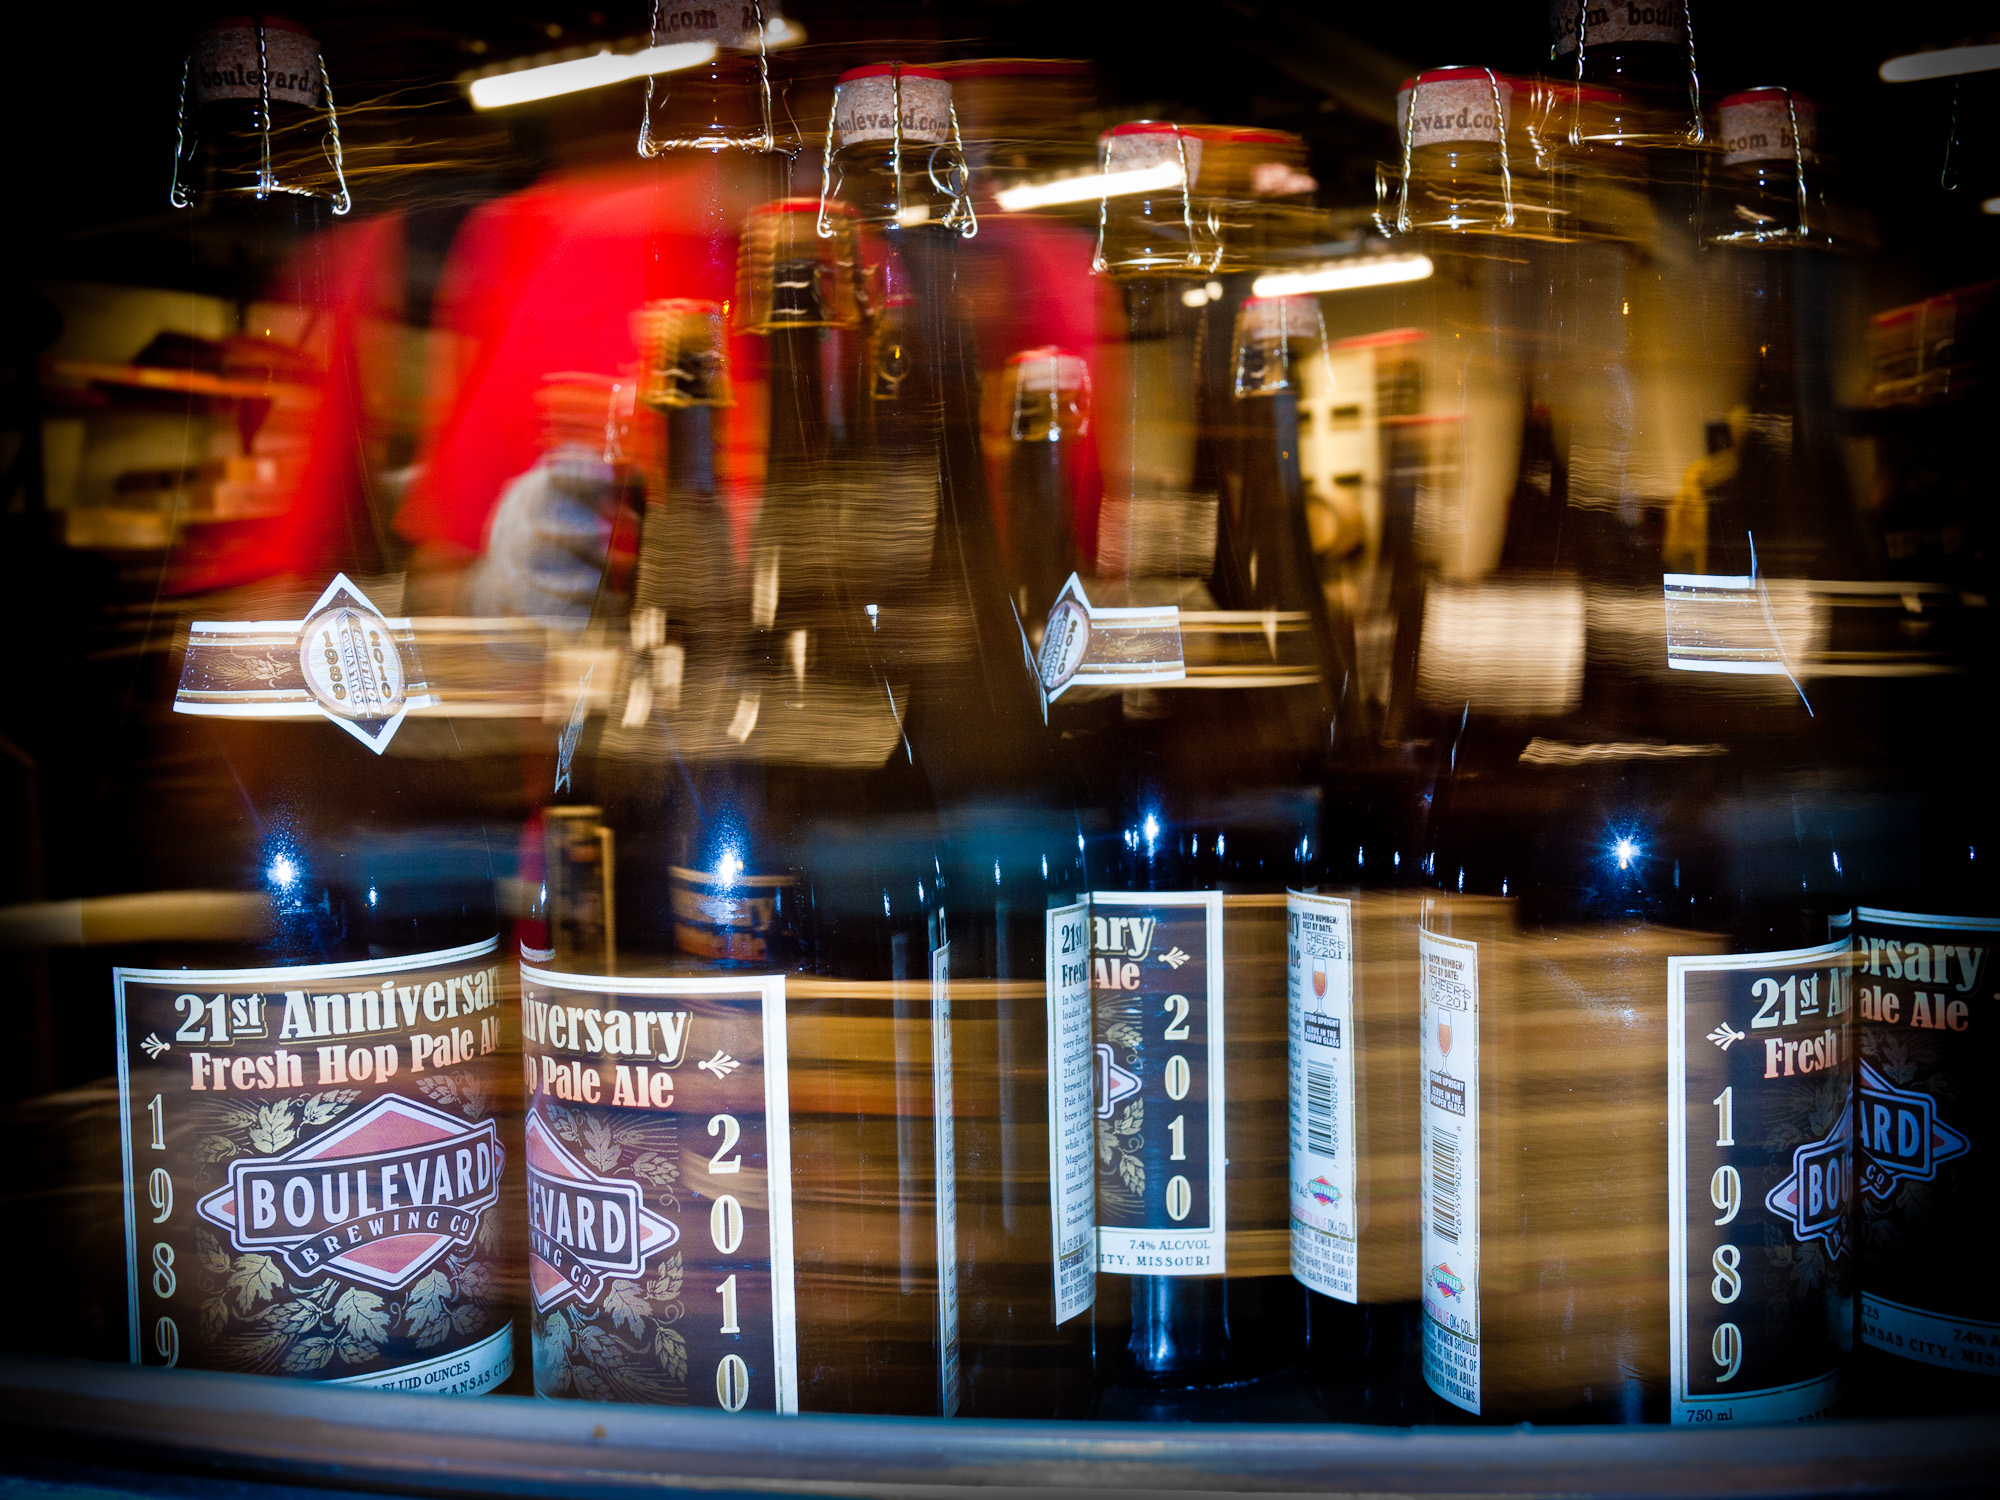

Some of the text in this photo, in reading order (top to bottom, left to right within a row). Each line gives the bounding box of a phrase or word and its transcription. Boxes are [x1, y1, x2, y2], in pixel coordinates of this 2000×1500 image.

[322, 630, 347, 700] 1989
[369, 630, 392, 699] 2010
[1306, 931, 1345, 950] CHEERS
[174, 965, 501, 1042] 21st Anniversar
[1431, 975, 1471, 999] CHEERS
[1751, 972, 1819, 1029] 21st
[1910, 991, 1969, 1031] Ale
[190, 1016, 500, 1091] Fresh Hop Pale Ale
[1764, 1028, 1838, 1079] Fresh
[542, 1055, 601, 1105] Pale
[611, 1065, 675, 1108] Ale
[1164, 994, 1191, 1222] 2010
[251, 1147, 491, 1230] BOULEVARD
[147, 1093, 180, 1369] 1989
[301, 1211, 440, 1266] BREWING
[1130, 1239, 1210, 1251] 7.4% ALC/VOL
[1710, 1085, 1742, 1383] 1989
[706, 1113, 750, 1413] 2010
[1136, 1254, 1210, 1267] MISSOURI
[425, 1360, 470, 1386] OUNCES
[1454, 1337, 1477, 1357] SHOULD
[1454, 1353, 1467, 1369] RISK
[1469, 1360, 1477, 1373] OF
[1961, 1349, 2000, 1367] MIS
[1446, 1381, 1478, 1405] PROBLEMS.
[1687, 1408, 1733, 1422] 750 ml
